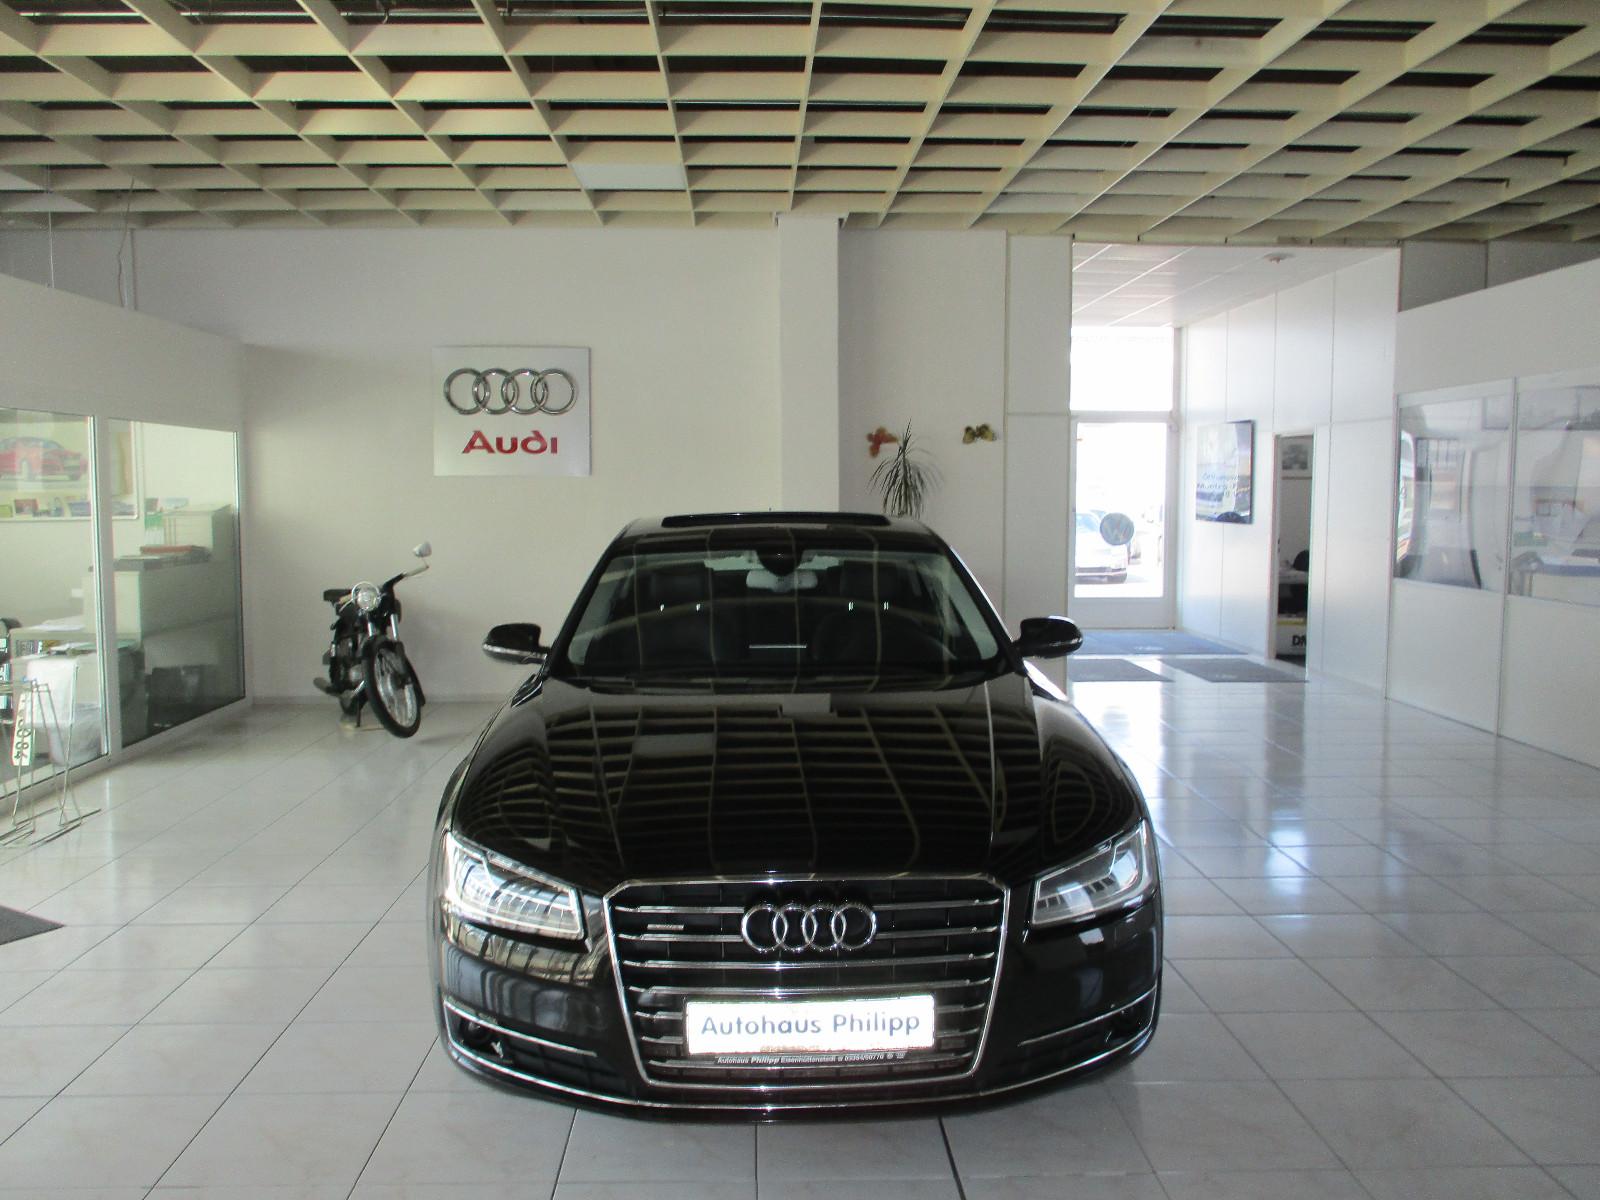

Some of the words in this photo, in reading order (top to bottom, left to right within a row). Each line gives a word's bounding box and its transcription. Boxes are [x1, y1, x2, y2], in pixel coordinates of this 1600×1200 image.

[461, 429, 558, 455] Audi
[700, 1015, 822, 1036] Autohaus
[832, 1010, 921, 1038] Philipp
[716, 1055, 749, 1064] Autohaus
[750, 1054, 780, 1065] Philipp
